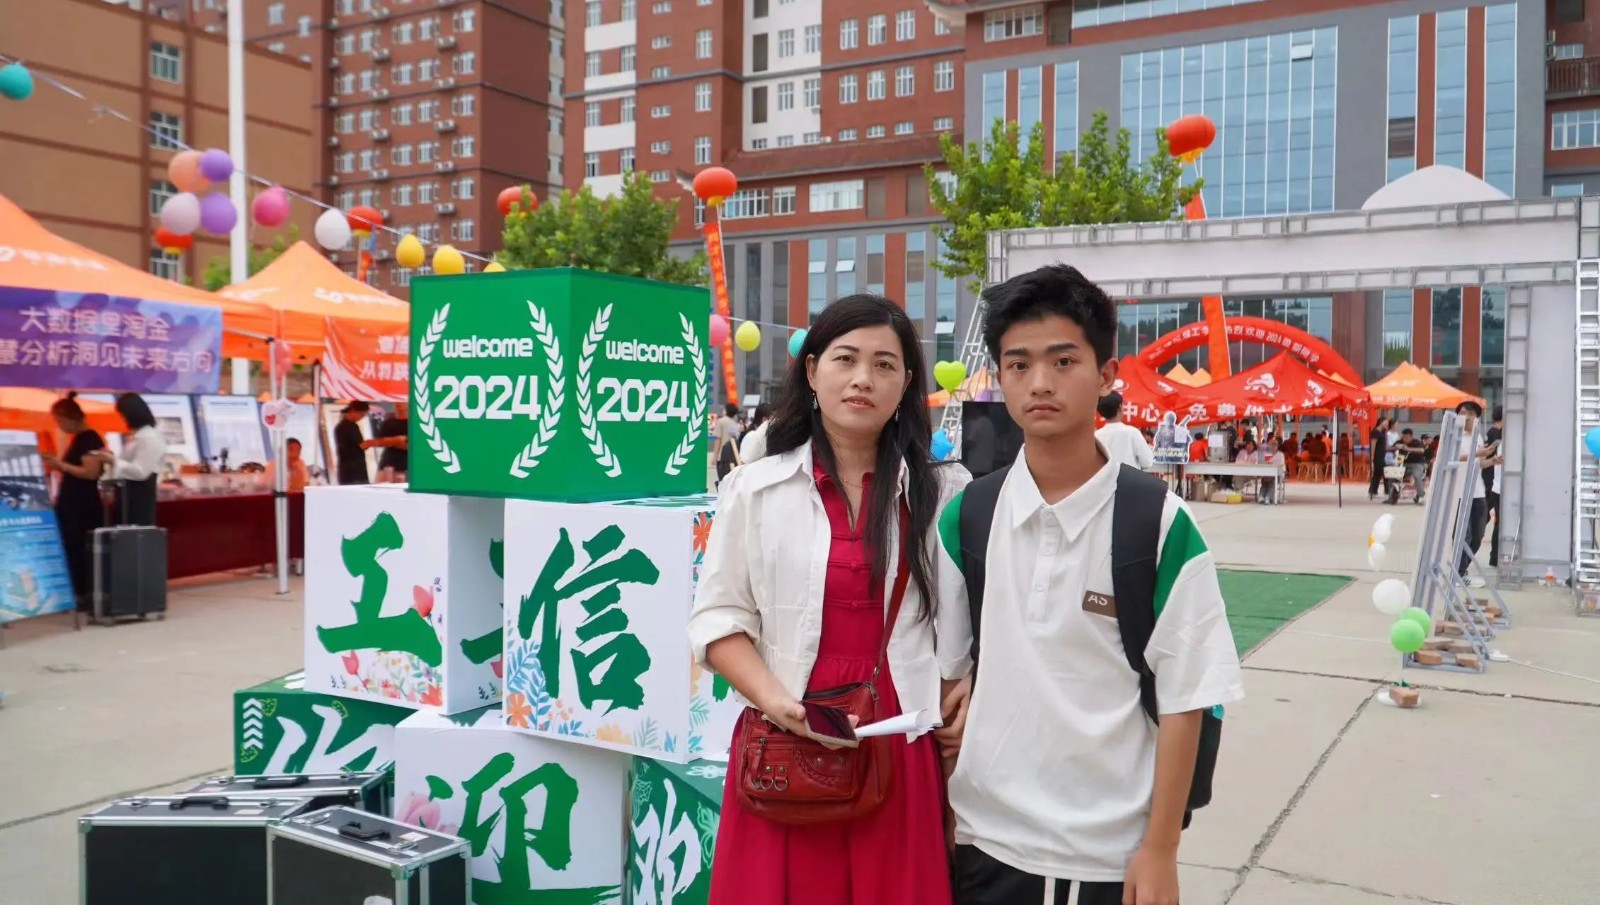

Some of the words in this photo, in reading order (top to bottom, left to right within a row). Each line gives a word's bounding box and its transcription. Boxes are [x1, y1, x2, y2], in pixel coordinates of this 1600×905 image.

[19, 307, 171, 341] 大数据里淘金
[443, 335, 533, 358] welcome
[606, 339, 684, 364] welcome
[434, 375, 541, 420] 2024
[597, 378, 690, 422] 2024
[1123, 401, 1160, 423] 中心
[316, 511, 443, 667] 工
[518, 524, 660, 717] 信
